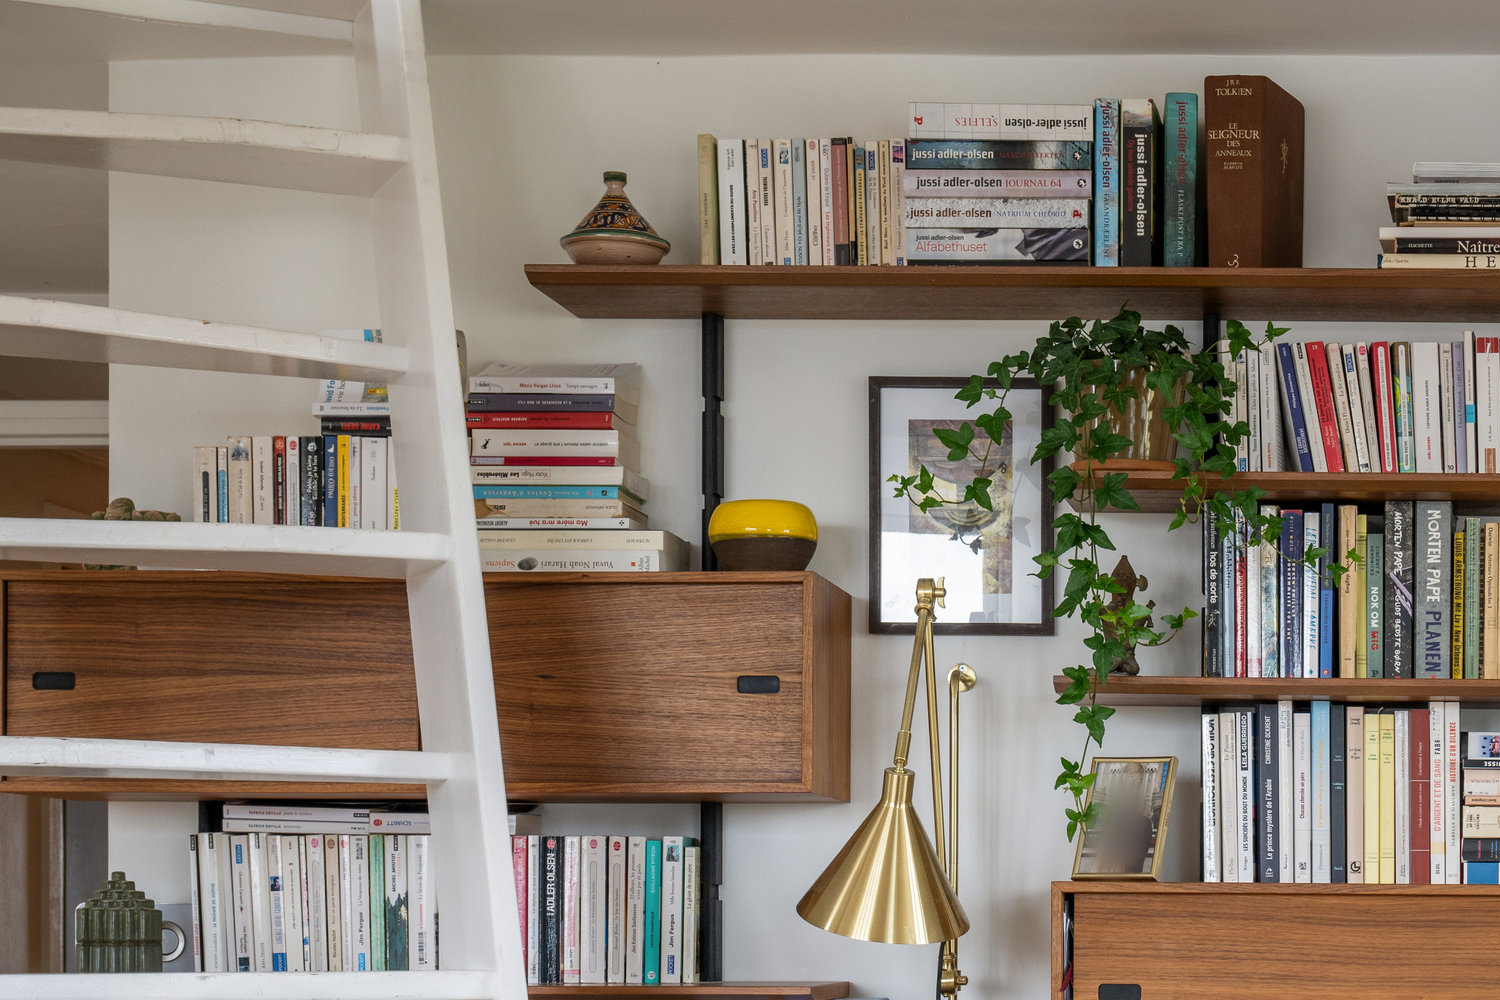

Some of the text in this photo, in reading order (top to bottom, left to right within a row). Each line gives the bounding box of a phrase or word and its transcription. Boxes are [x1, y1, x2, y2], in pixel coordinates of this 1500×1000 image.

[1215, 88, 1252, 96] TOLKIEN
[1101, 105, 1112, 127] jussi
[955, 117, 1087, 130] jussi adler-olsen SELFIES
[1229, 122, 1239, 130] LE
[1208, 130, 1260, 140] SEIGNEUR
[912, 147, 994, 161] jussi adler-olsen
[1102, 131, 1111, 188] adler-olsen
[1215, 150, 1252, 158] ANNEAUX
[916, 176, 1047, 192] jussi adler-olsen JOURNAL
[1135, 133, 1148, 236] jussi adler-olsen
[910, 206, 992, 220] jussi adler-olsen
[915, 241, 988, 253] Alfabethuset
[1457, 240, 1500, 253] Naître
[1394, 511, 1403, 576] MORTEN PAPE
[486, 558, 614, 569] Yuval Noah Harari Sapiens
[1210, 552, 1218, 566] hos
[1210, 569, 1218, 580] de
[1425, 510, 1441, 672] MORTEN PAPE PLANEN
[1371, 612, 1378, 627] OM
[546, 853, 555, 912] ADLER-OLSEN
